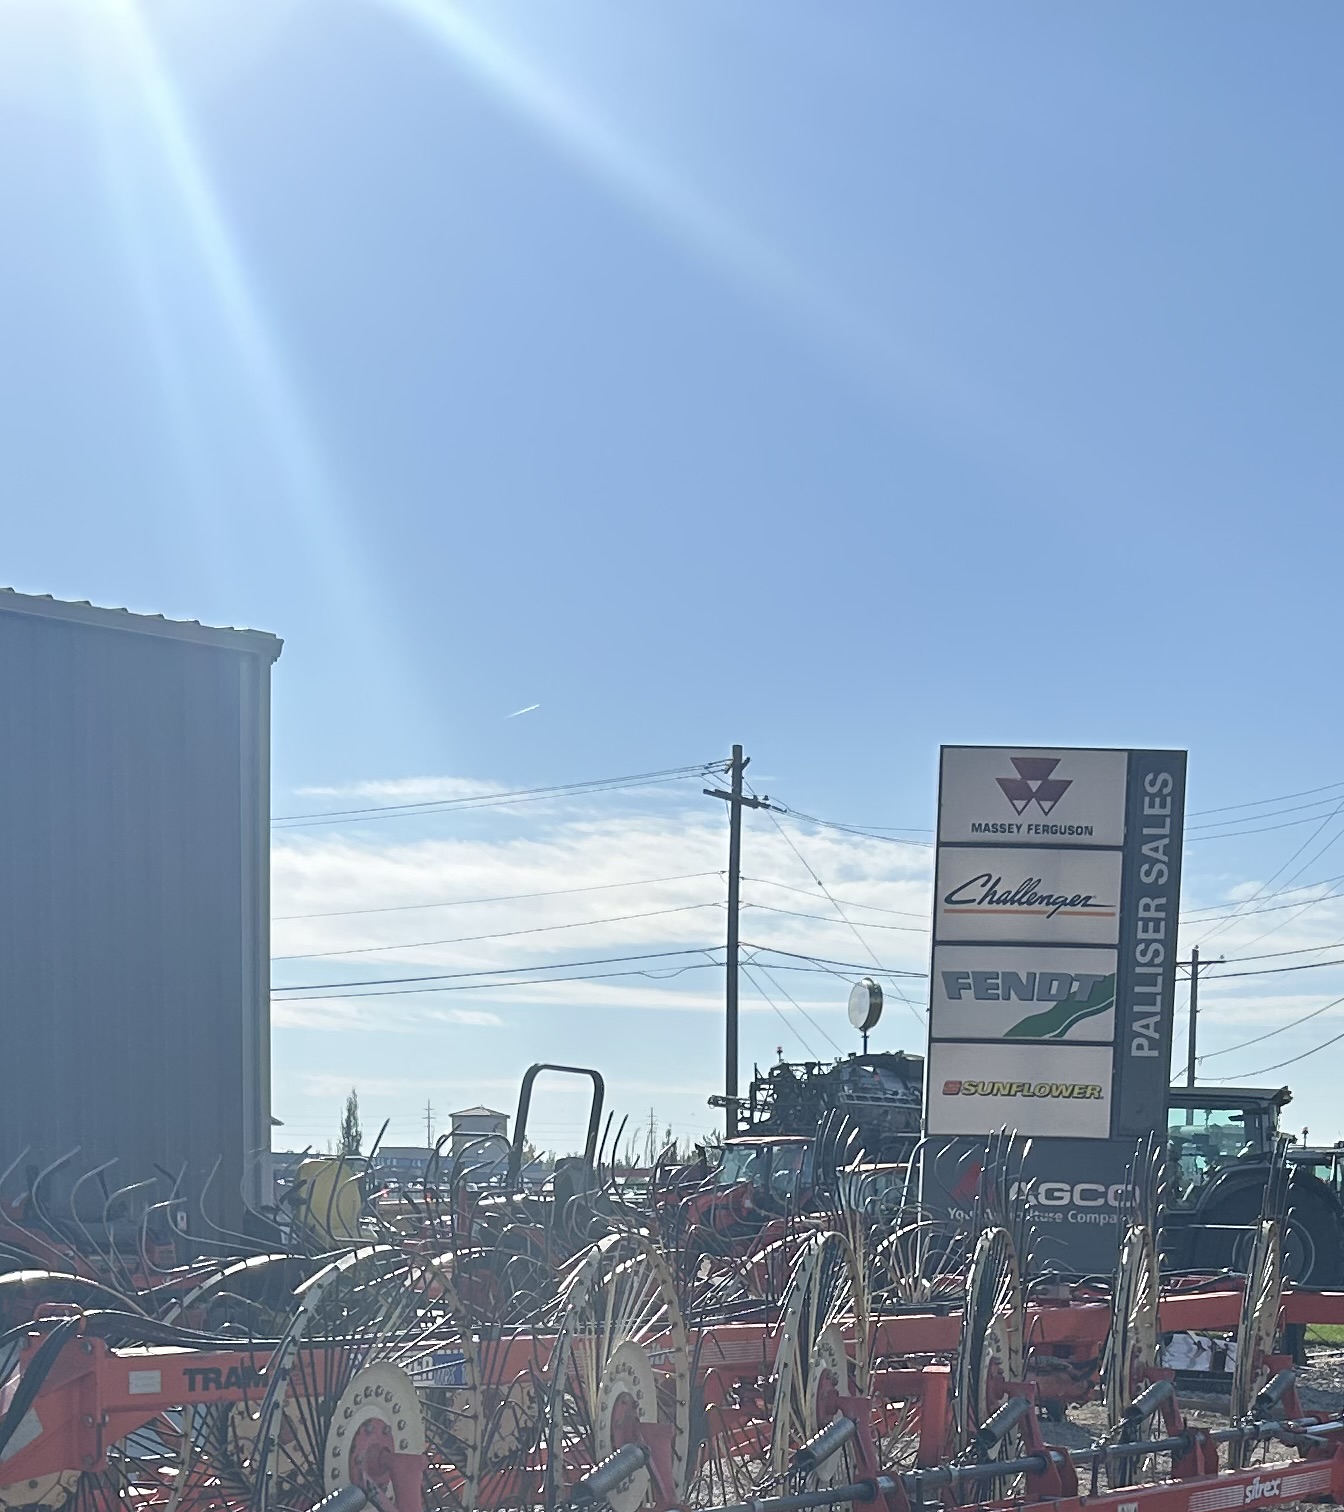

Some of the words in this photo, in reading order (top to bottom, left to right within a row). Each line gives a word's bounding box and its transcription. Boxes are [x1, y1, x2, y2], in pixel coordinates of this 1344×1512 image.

[971, 822, 1023, 834] MASSEY
[1027, 824, 1094, 836] FERGUSON
[1139, 772, 1174, 886] SALES
[944, 872, 1116, 919] Challenger
[941, 970, 1107, 1002] FENDT
[1130, 896, 1168, 1058] PALLISER
[961, 1080, 1103, 1101] SUNFLOWER
[1009, 1181, 1141, 1207] AGCO
